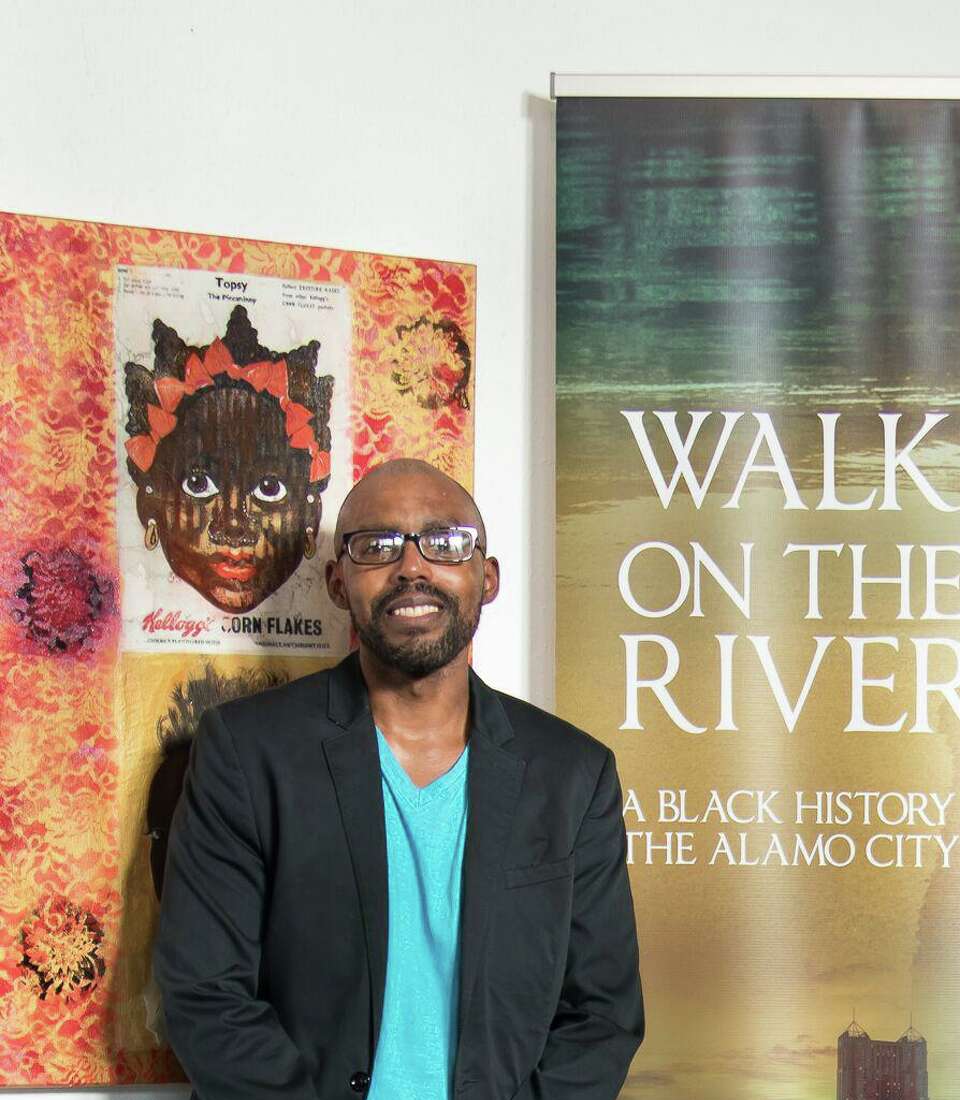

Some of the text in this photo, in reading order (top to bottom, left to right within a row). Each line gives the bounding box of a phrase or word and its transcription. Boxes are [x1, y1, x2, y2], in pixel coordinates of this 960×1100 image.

[215, 276, 248, 292] Topsy
[620, 410, 960, 512] WALK
[618, 541, 754, 619] ON
[267, 617, 322, 636] FLAKES
[623, 789, 645, 823] A
[658, 789, 784, 824] BLACK
[795, 790, 955, 826] HISTORY
[626, 832, 960, 868] THE ALAMO CITY
